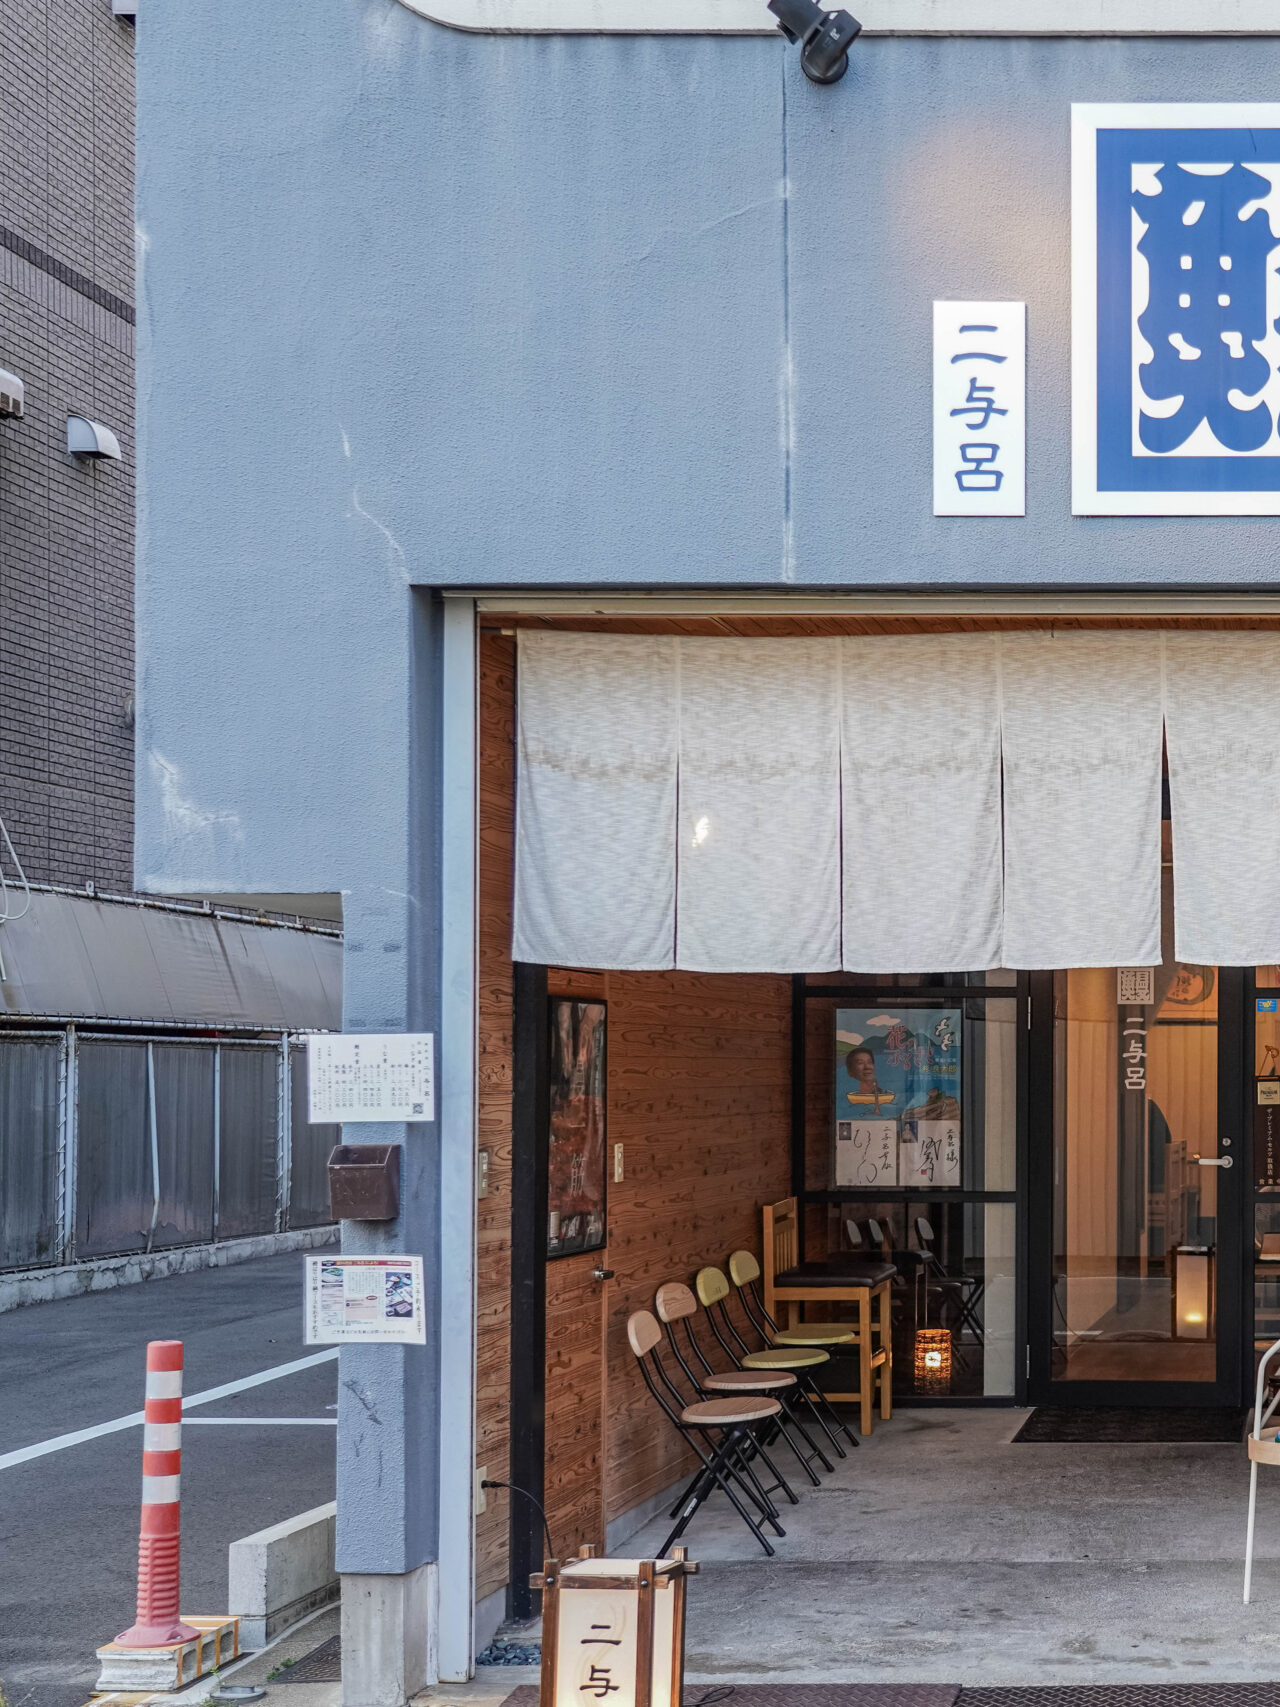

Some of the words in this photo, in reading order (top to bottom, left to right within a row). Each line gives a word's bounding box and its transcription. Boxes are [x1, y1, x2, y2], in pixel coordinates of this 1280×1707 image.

[949, 324, 1008, 492] 二与呂
[1122, 1017, 1148, 1090] 二与呂
[579, 1623, 622, 1698] 二与
